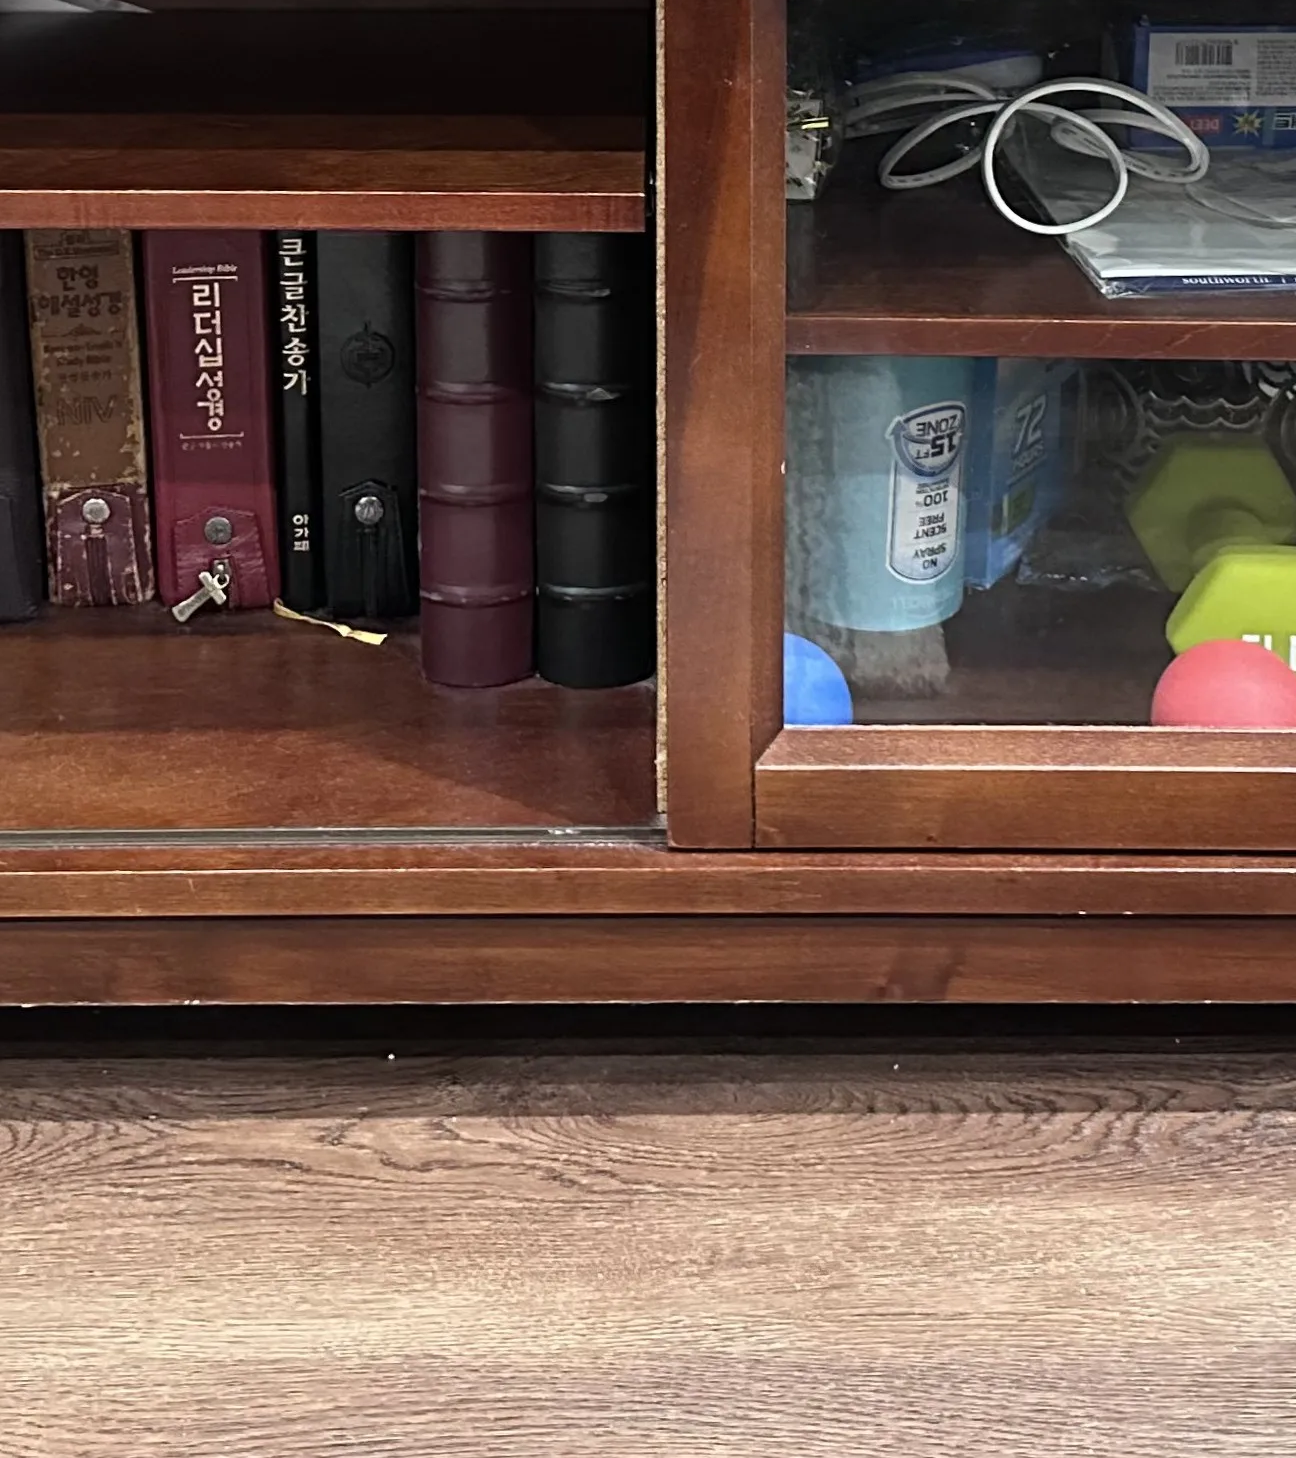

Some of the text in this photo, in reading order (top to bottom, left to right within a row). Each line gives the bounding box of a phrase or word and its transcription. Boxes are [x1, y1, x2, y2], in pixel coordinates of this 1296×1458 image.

[56, 263, 99, 292] 한영
[38, 291, 122, 318] 해설성경
[192, 282, 224, 431] 리더십성경
[56, 395, 117, 427] NIV
[916, 413, 959, 437] ZONE
[1014, 393, 1047, 455] 72
[914, 430, 956, 460] 15 FT
[292, 514, 310, 552] 아가페
[913, 523, 947, 540] SCENT
[918, 512, 945, 527] FREE
[912, 542, 947, 560] SPRAY
[922, 558, 937, 571] NO
